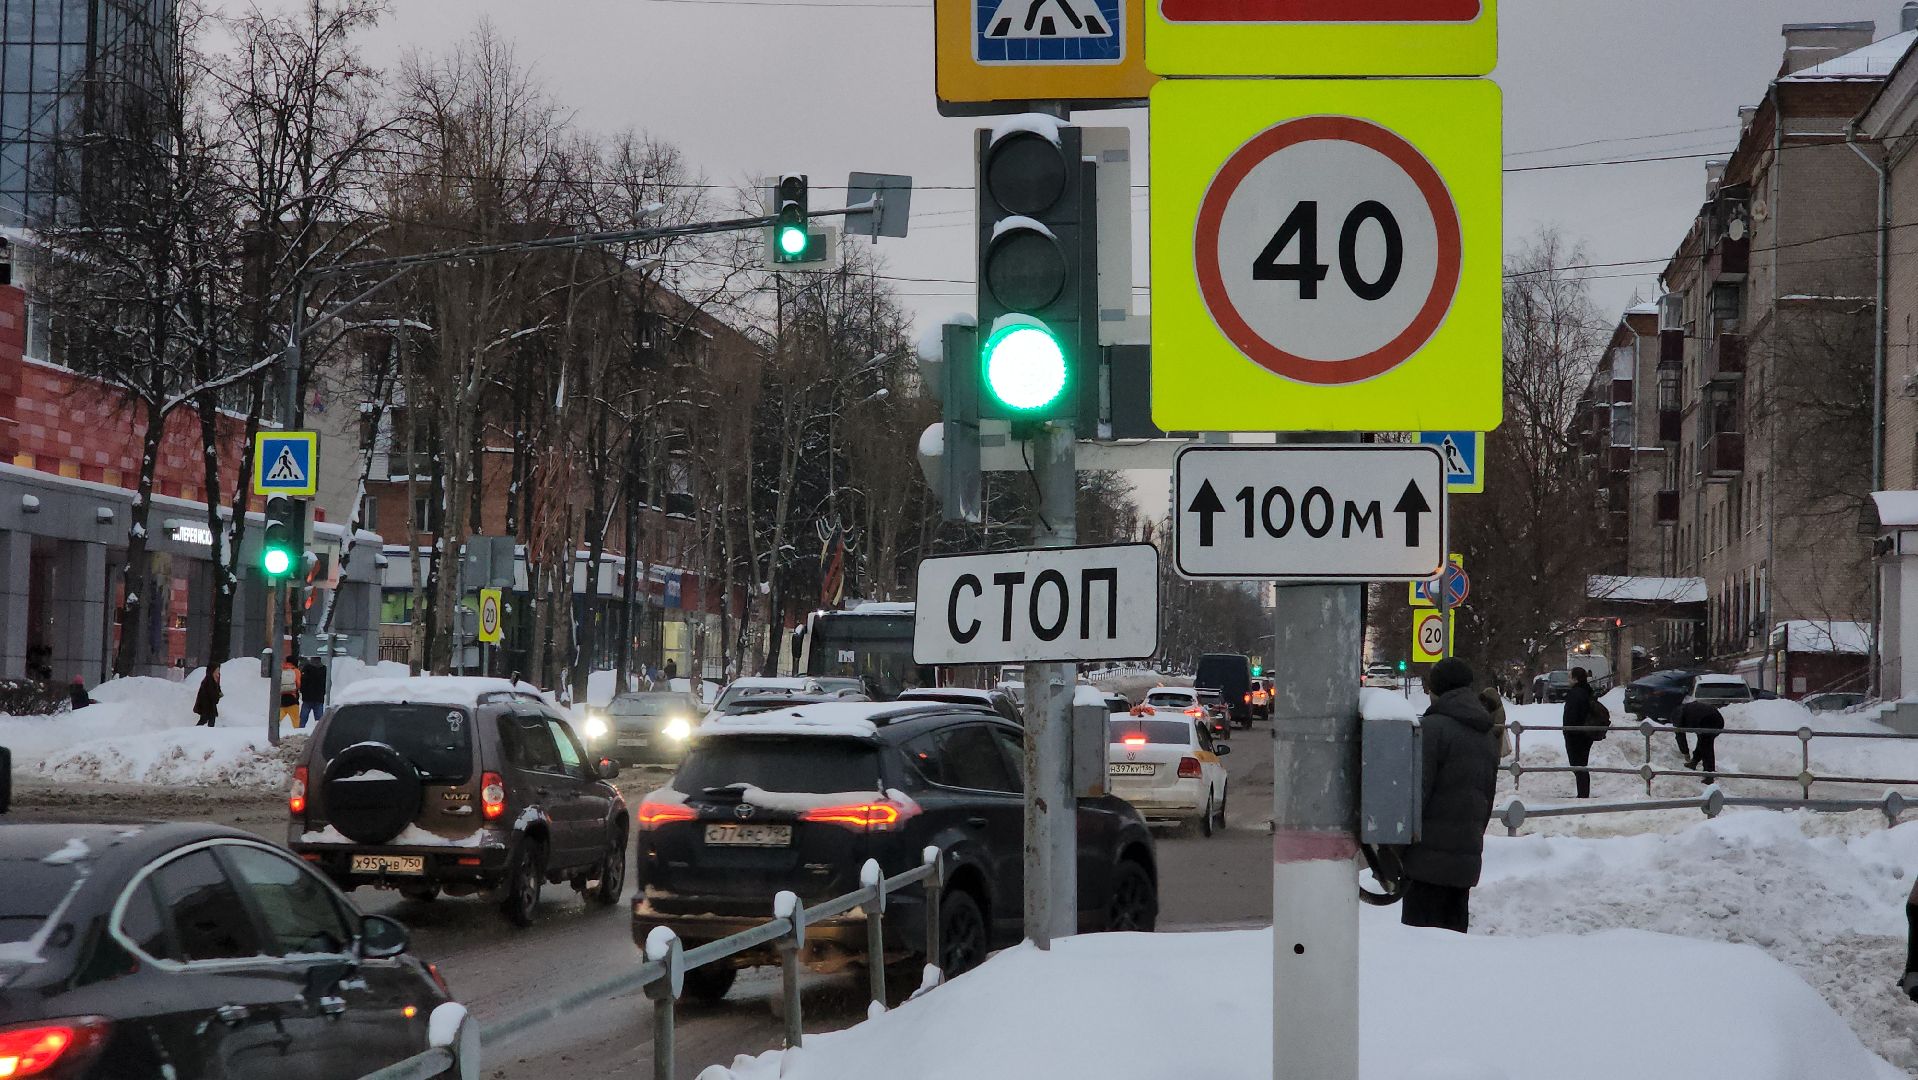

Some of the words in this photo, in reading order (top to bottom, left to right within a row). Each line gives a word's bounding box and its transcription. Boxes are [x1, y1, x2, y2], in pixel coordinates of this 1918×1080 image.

[1253, 200, 1403, 300] 40
[485, 608, 495, 623] 20
[948, 567, 1118, 645] СТОП
[1425, 628, 1441, 643] 20
